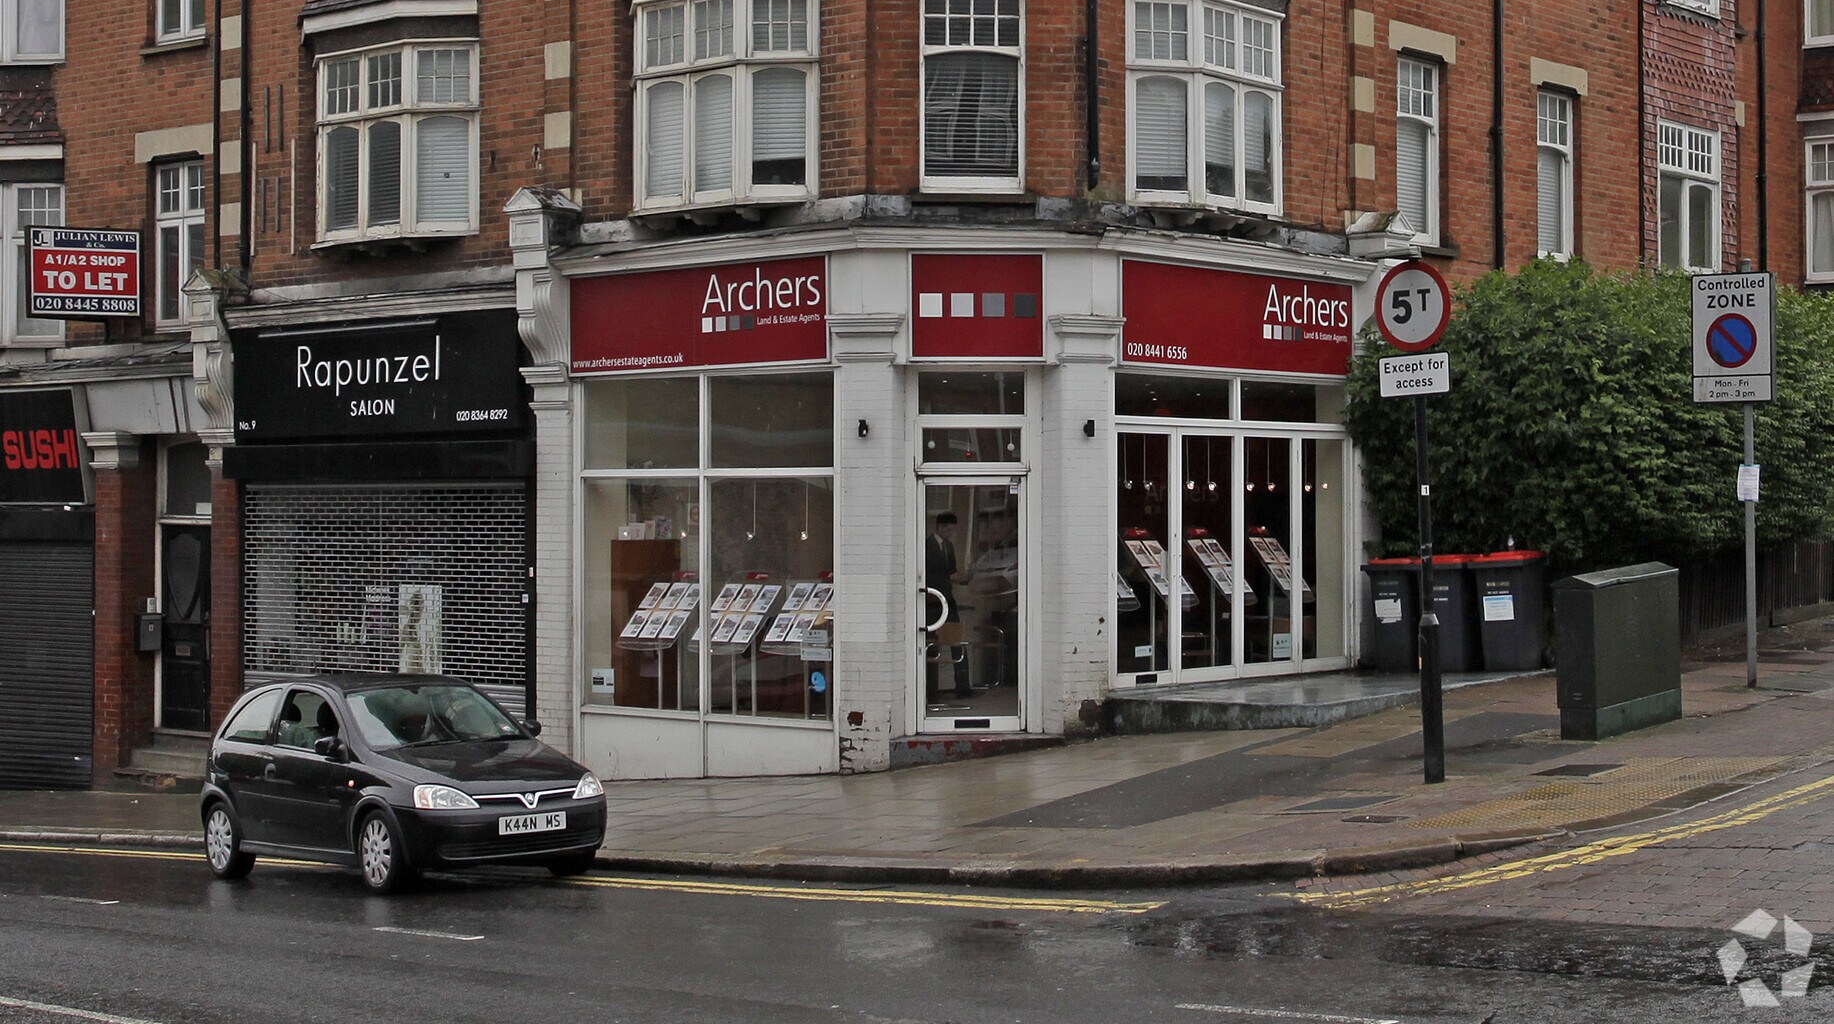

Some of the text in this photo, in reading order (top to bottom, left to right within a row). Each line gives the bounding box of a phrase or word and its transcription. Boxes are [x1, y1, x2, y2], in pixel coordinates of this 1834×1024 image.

[55, 232, 136, 243] JULIAN LEWIS
[45, 254, 126, 266] A1/A2 SHOP
[42, 271, 128, 290] TO LET
[1697, 277, 1765, 291] Controlled
[701, 267, 821, 314] Archers
[36, 297, 136, 312] 020 8445 8808
[1263, 283, 1349, 328] Archers
[1706, 293, 1756, 309] ZONE
[756, 316, 772, 325] Land
[779, 315, 798, 324] Estate
[798, 313, 821, 324] Agents
[1303, 331, 1315, 340] Land
[1315, 331, 1319, 340] &
[1319, 332, 1333, 341] Estate
[1127, 342, 1188, 360] 020 8441 6556
[296, 334, 441, 397] Rapunzel
[572, 353, 684, 368] www.archersestateagents.co.uk
[1384, 358, 1445, 375] Except for
[1395, 377, 1434, 390] access
[1714, 380, 1732, 388] Mon
[1738, 379, 1749, 387] Fri
[350, 398, 395, 417] SALON
[456, 409, 507, 422] 020 8364 8292
[239, 420, 257, 430] No. 9
[2, 429, 79, 470] SUSHI
[505, 815, 560, 832] K44N MS
